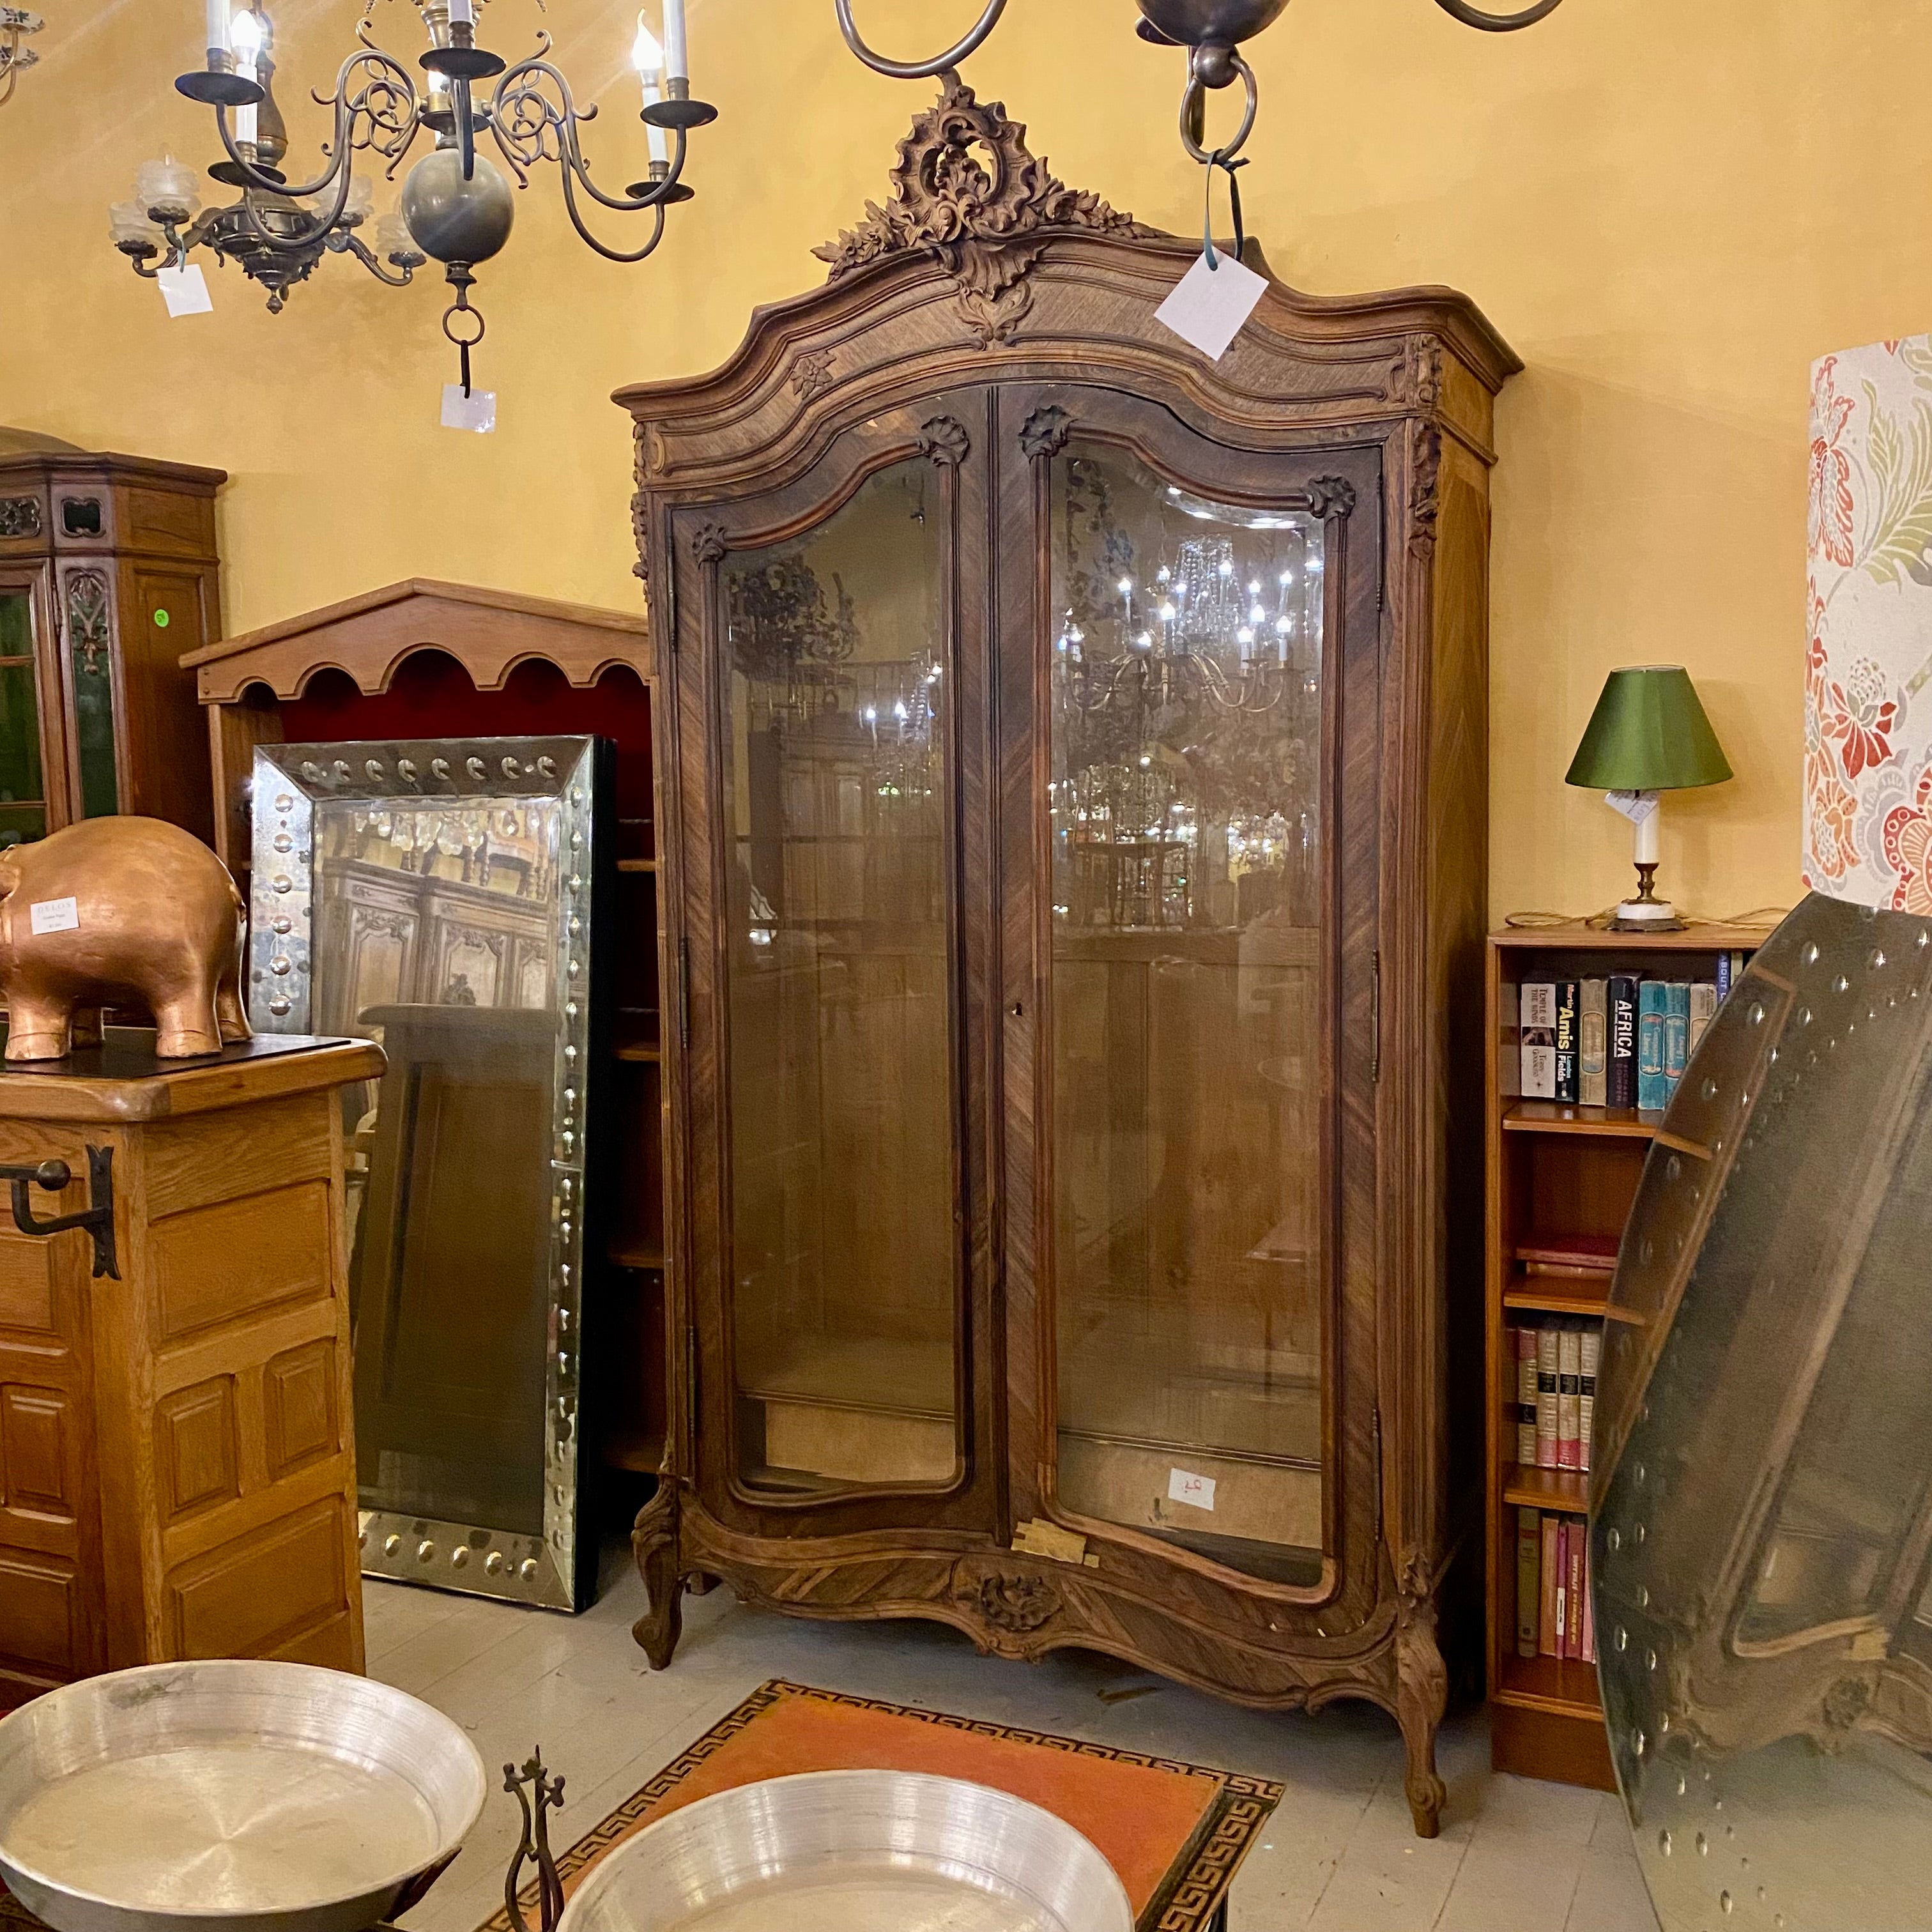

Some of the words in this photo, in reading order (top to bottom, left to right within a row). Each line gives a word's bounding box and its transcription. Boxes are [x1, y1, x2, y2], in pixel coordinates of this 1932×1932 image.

[1567, 984, 1575, 1009] Martin
[1558, 1006, 1574, 1050] Amis
[1617, 1000, 1632, 1058] AFRICA
[1557, 1055, 1566, 1082] Fields
